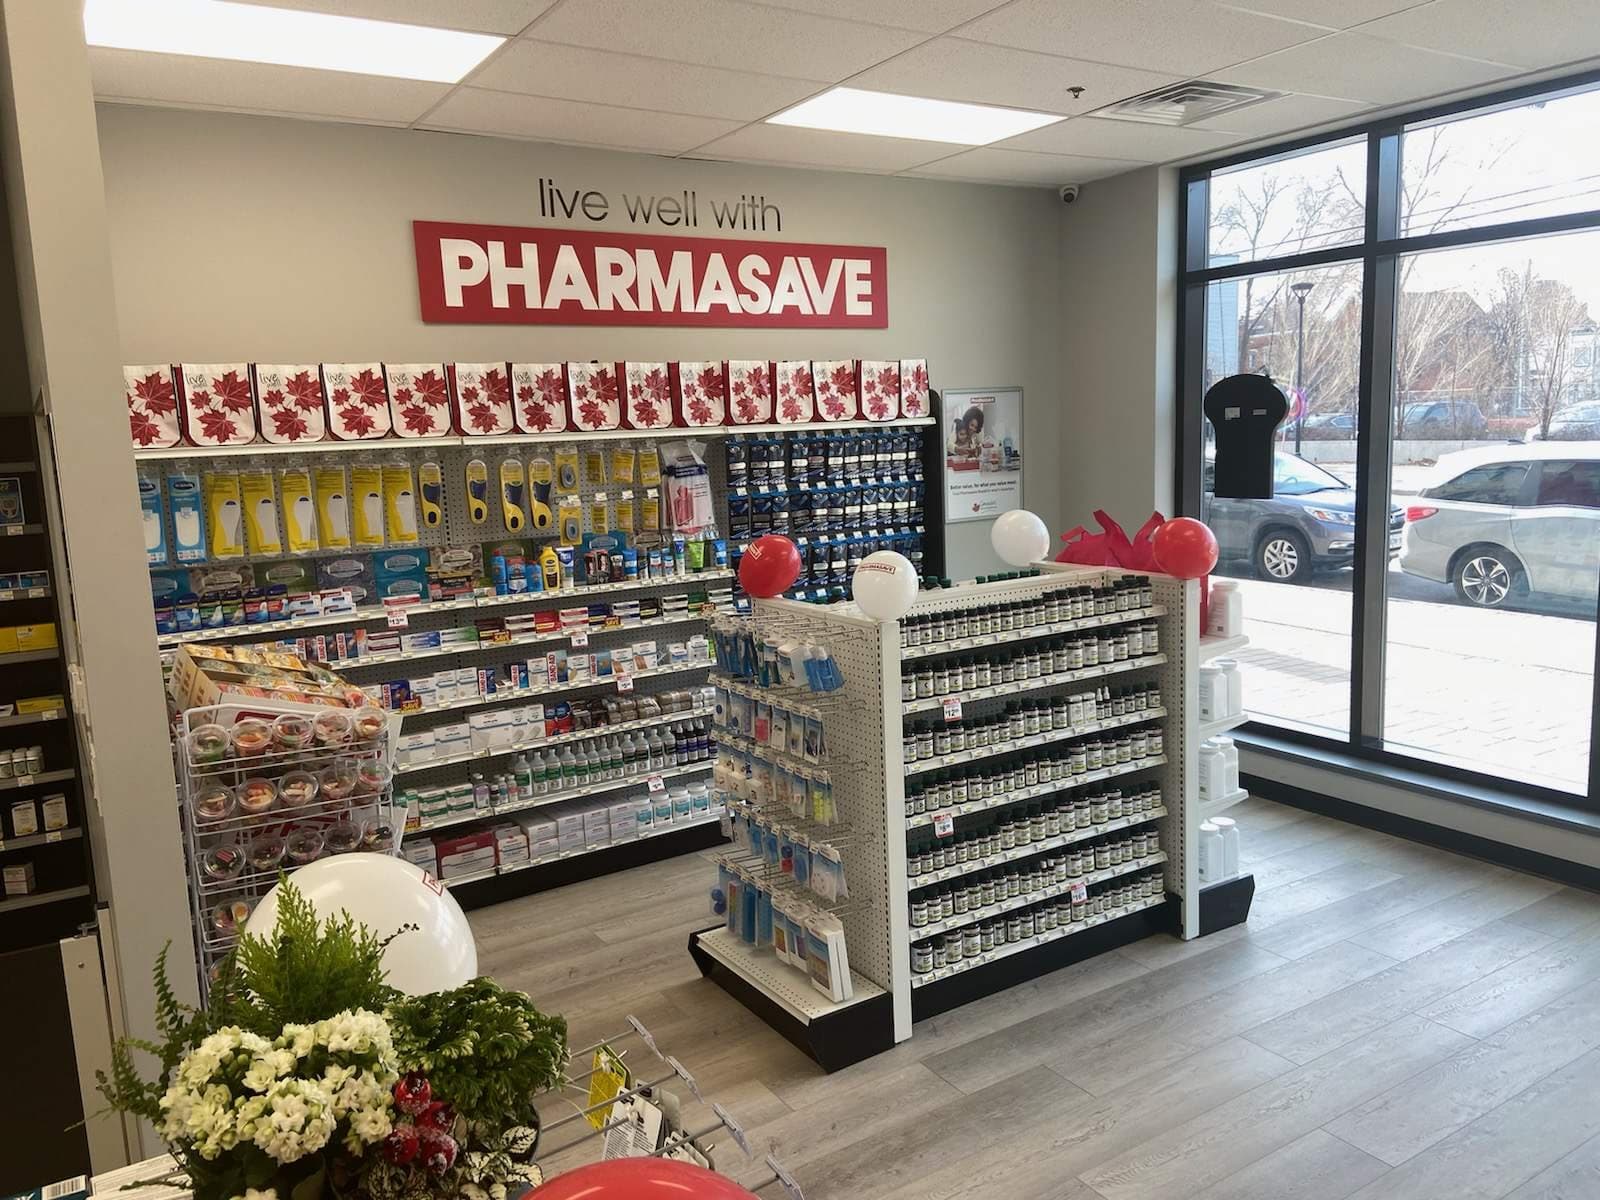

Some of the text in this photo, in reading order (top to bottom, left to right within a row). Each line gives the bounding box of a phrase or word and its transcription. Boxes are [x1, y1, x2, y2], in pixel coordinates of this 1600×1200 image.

[539, 178, 781, 232] live well with
[440, 238, 873, 316] PHARMASAVE
[549, 654, 557, 682] BAND-AID
